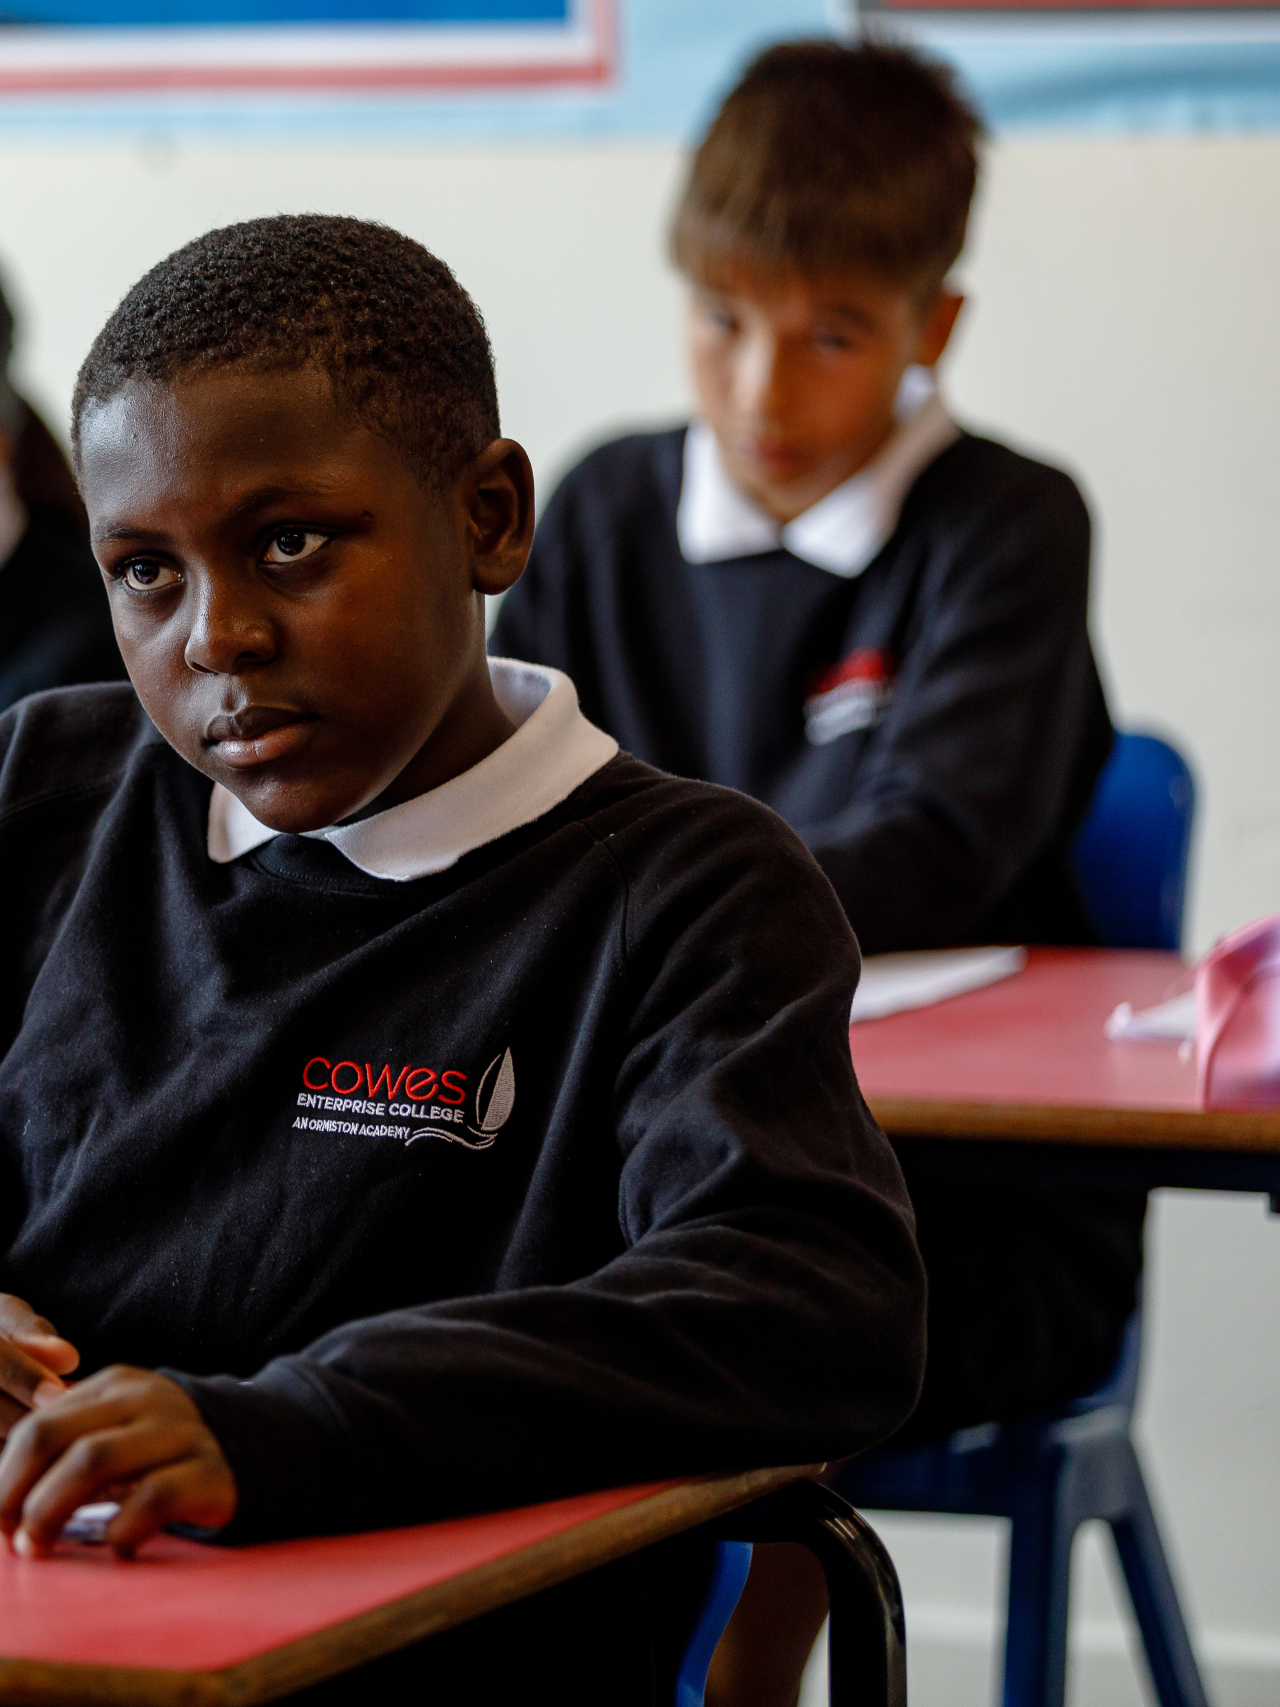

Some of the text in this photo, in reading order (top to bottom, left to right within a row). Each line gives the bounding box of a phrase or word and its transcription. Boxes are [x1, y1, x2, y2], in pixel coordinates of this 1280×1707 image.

[297, 1093, 465, 1124] ENTERPRISE COLLEGE
[292, 1116, 411, 1140] AN ORMISTON ACADEMY
